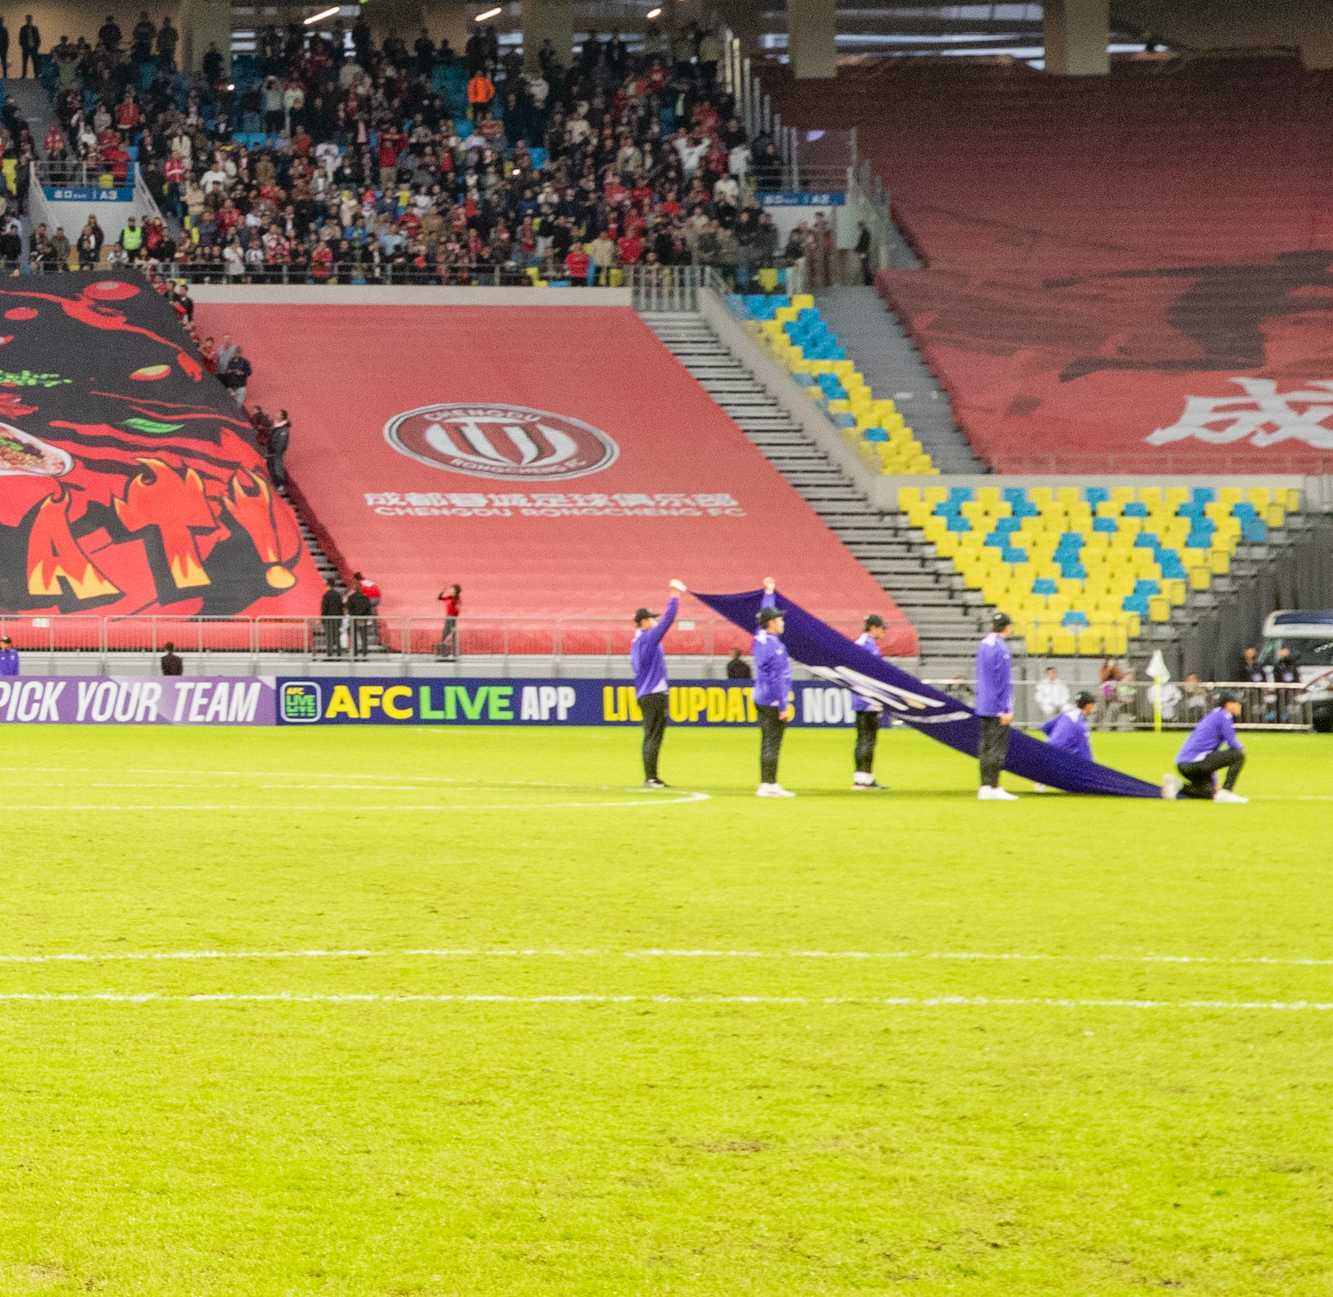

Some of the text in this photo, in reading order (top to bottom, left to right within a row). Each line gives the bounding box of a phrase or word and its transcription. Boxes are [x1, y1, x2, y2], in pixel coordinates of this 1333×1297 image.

[374, 506, 512, 517] CHENGDU
[76, 682, 163, 722] YOUR
[173, 682, 261, 722] TEAM
[325, 685, 413, 719] AFC
[419, 686, 514, 720] LIVE
[521, 686, 576, 720] APP
